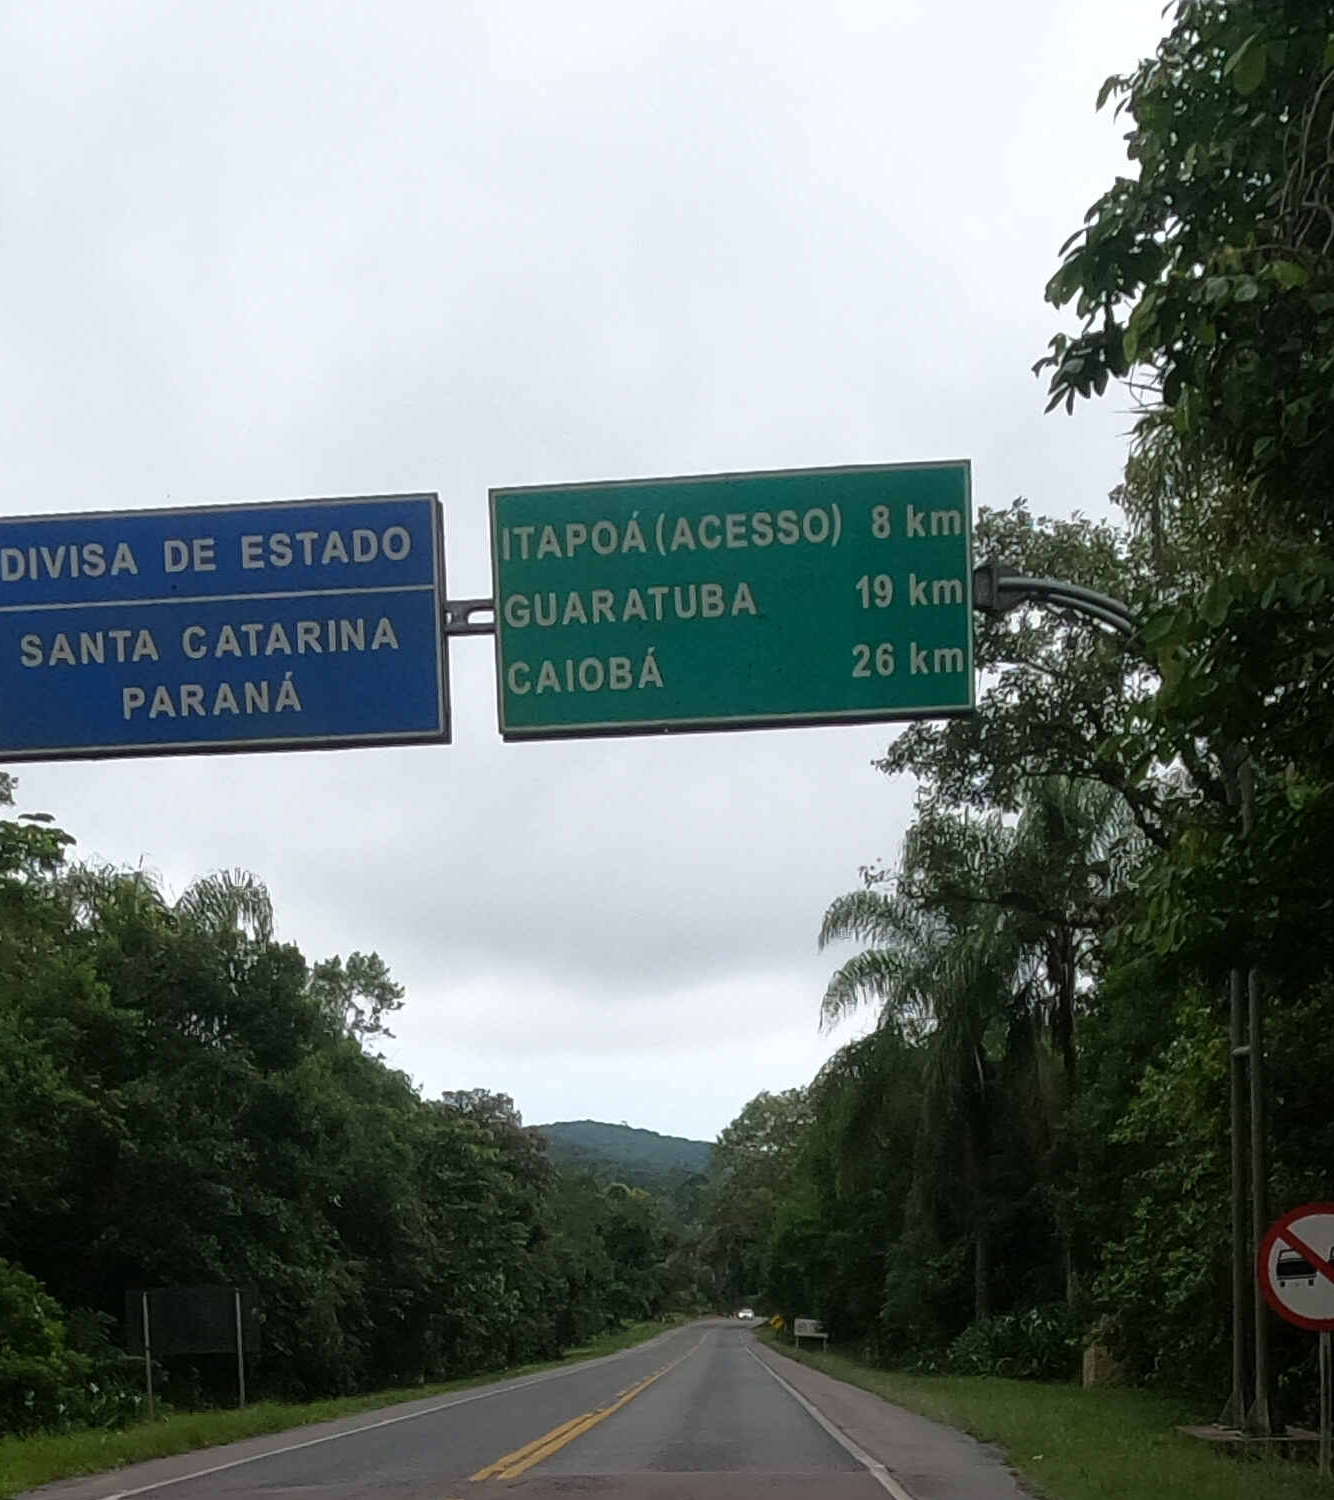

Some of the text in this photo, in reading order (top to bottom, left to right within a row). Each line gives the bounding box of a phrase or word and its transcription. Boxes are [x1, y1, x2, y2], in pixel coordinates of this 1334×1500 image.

[871, 504, 891, 539] 8
[906, 503, 963, 538] km
[0, 526, 412, 582] DIVISA DE ESTADO
[504, 573, 964, 628] GUARATUBA 19 km
[20, 617, 400, 668] SANTA CATARINA
[507, 642, 964, 695] CAIOBÁ 26 km
[122, 672, 303, 720] PARANÁ
